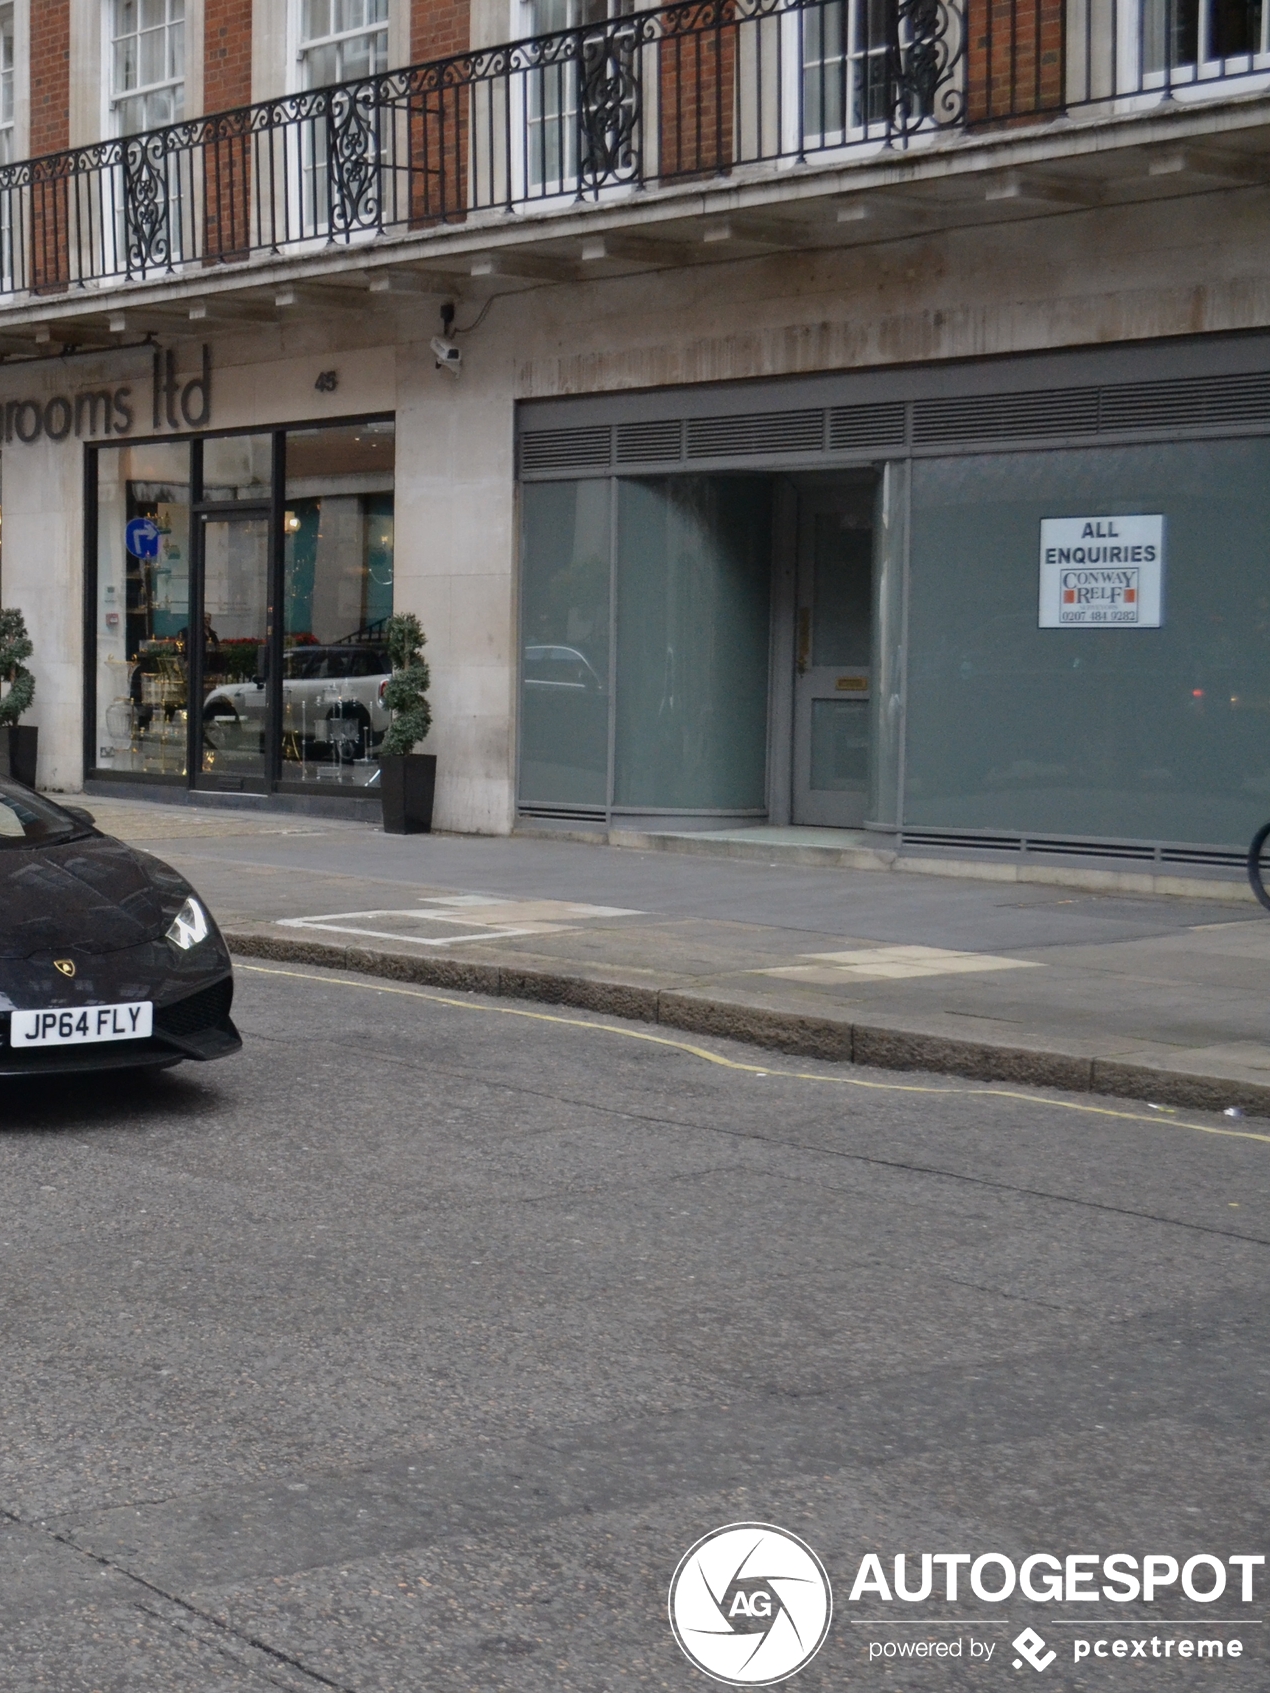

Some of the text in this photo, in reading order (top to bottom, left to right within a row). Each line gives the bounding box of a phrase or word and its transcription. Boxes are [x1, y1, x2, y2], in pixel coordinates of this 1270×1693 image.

[152, 343, 212, 429] ltd
[1081, 521, 1119, 539] ALL
[1045, 545, 1156, 565] ENQUIRIES
[1063, 571, 1136, 589] CONWAY
[1076, 586, 1123, 604] RELF
[1062, 611, 1086, 621] 0207
[1111, 610, 1136, 621] 9282
[25, 1006, 141, 1040] JP64 FLY
